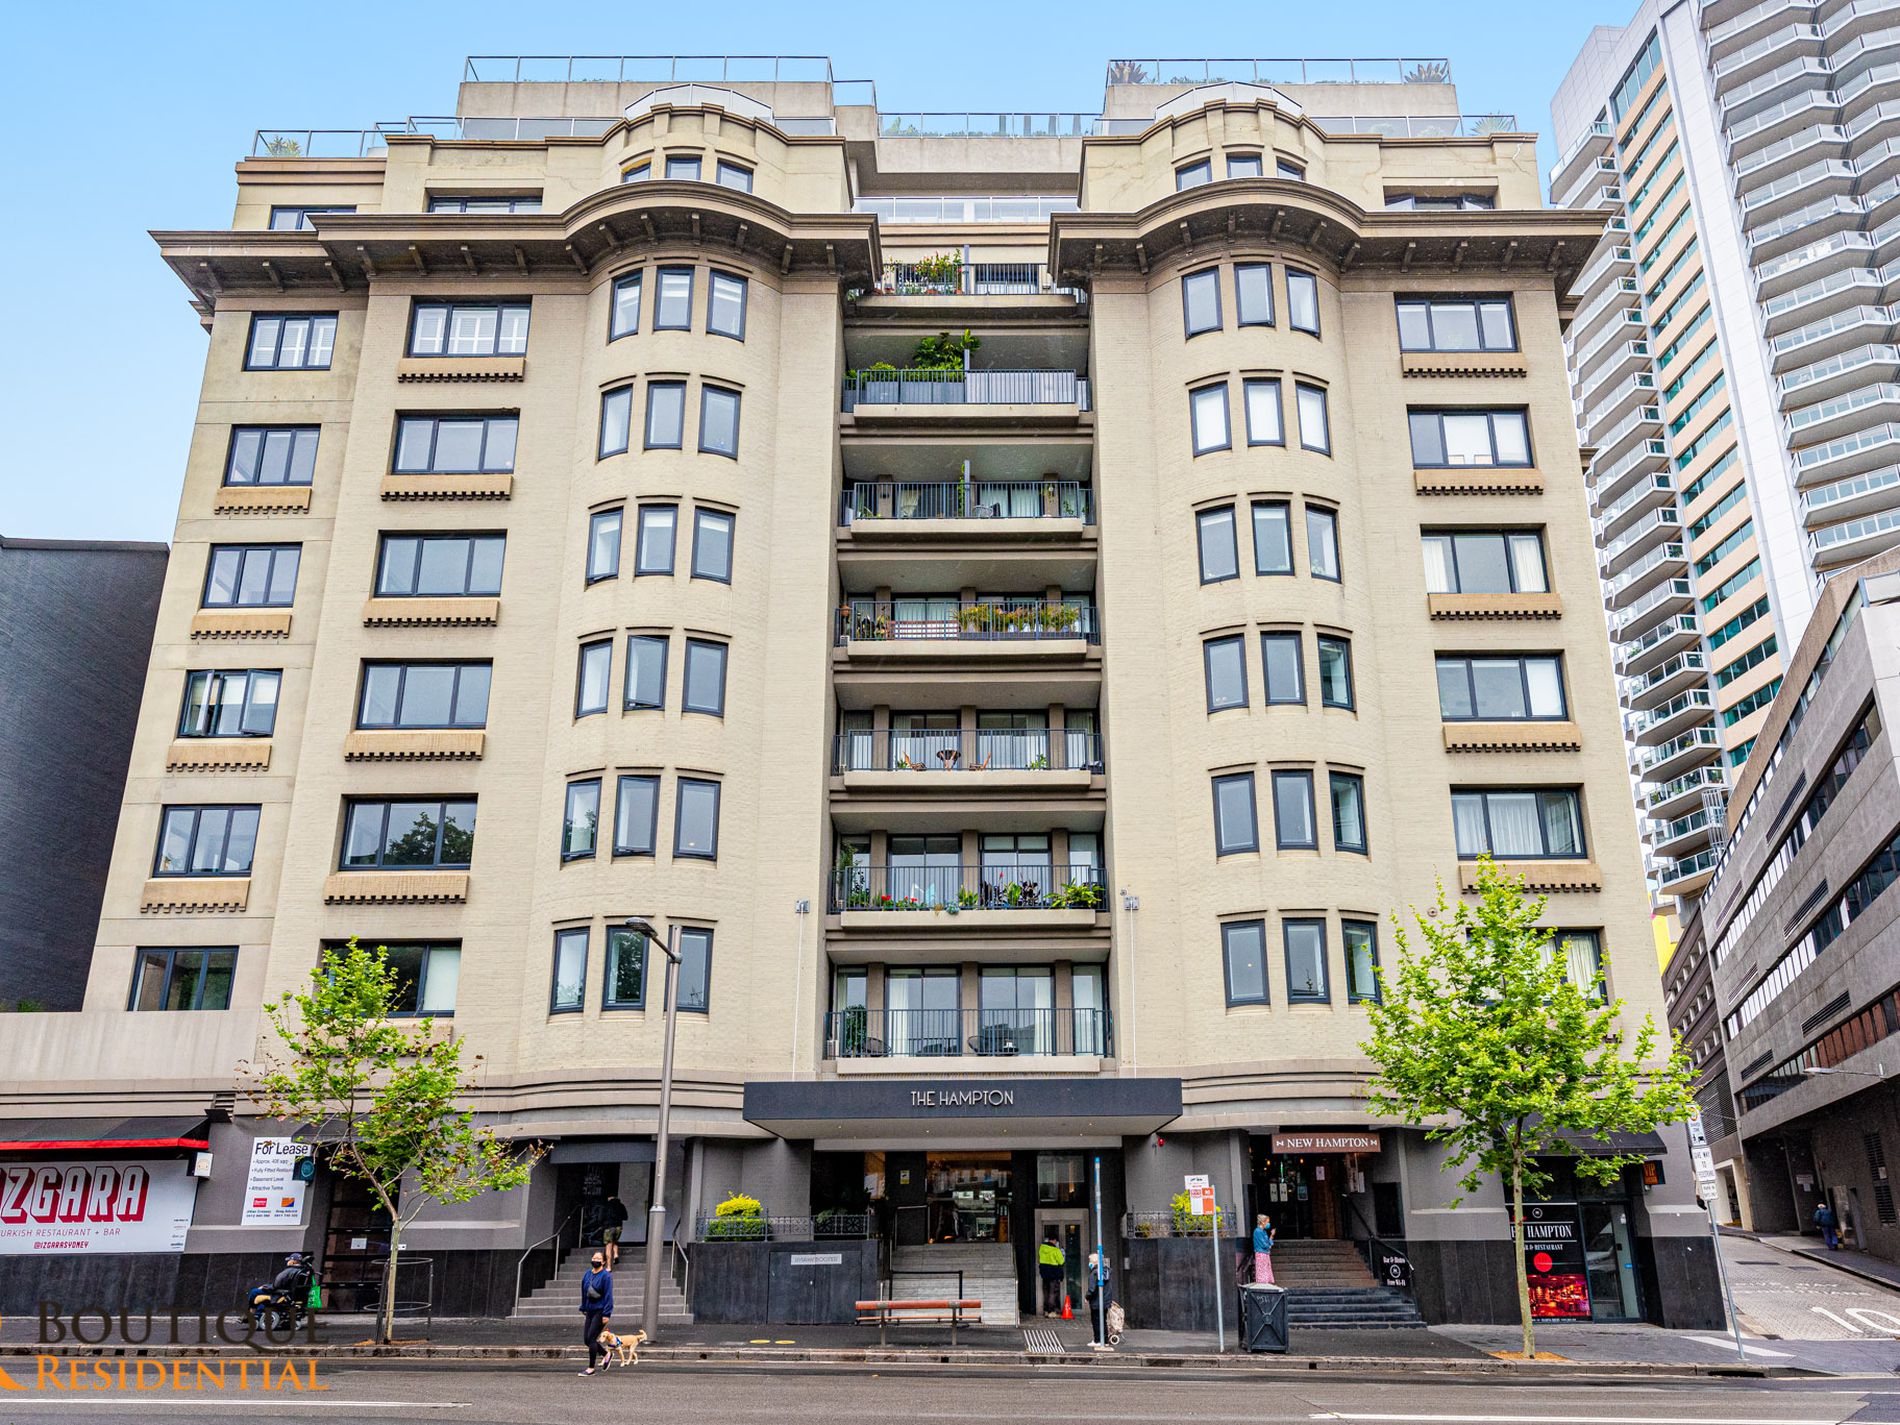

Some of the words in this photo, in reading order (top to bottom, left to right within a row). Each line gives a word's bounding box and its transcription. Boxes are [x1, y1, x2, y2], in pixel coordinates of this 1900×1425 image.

[911, 1091, 935, 1106] THE
[940, 1090, 1014, 1105] HAMPTON
[255, 1142, 275, 1155] For
[276, 1142, 308, 1155] Lease
[1287, 1138, 1312, 1148] NEW
[1316, 1138, 1368, 1147] HAMPTON
[0, 1165, 150, 1224] ZGARA
[0, 1229, 33, 1237] URKISH
[36, 1228, 91, 1237] RESTAURANT
[103, 1228, 121, 1236] BAR
[1527, 1225, 1572, 1238] HAMPTON
[34, 1241, 89, 1249] @IZGARASYDNEY
